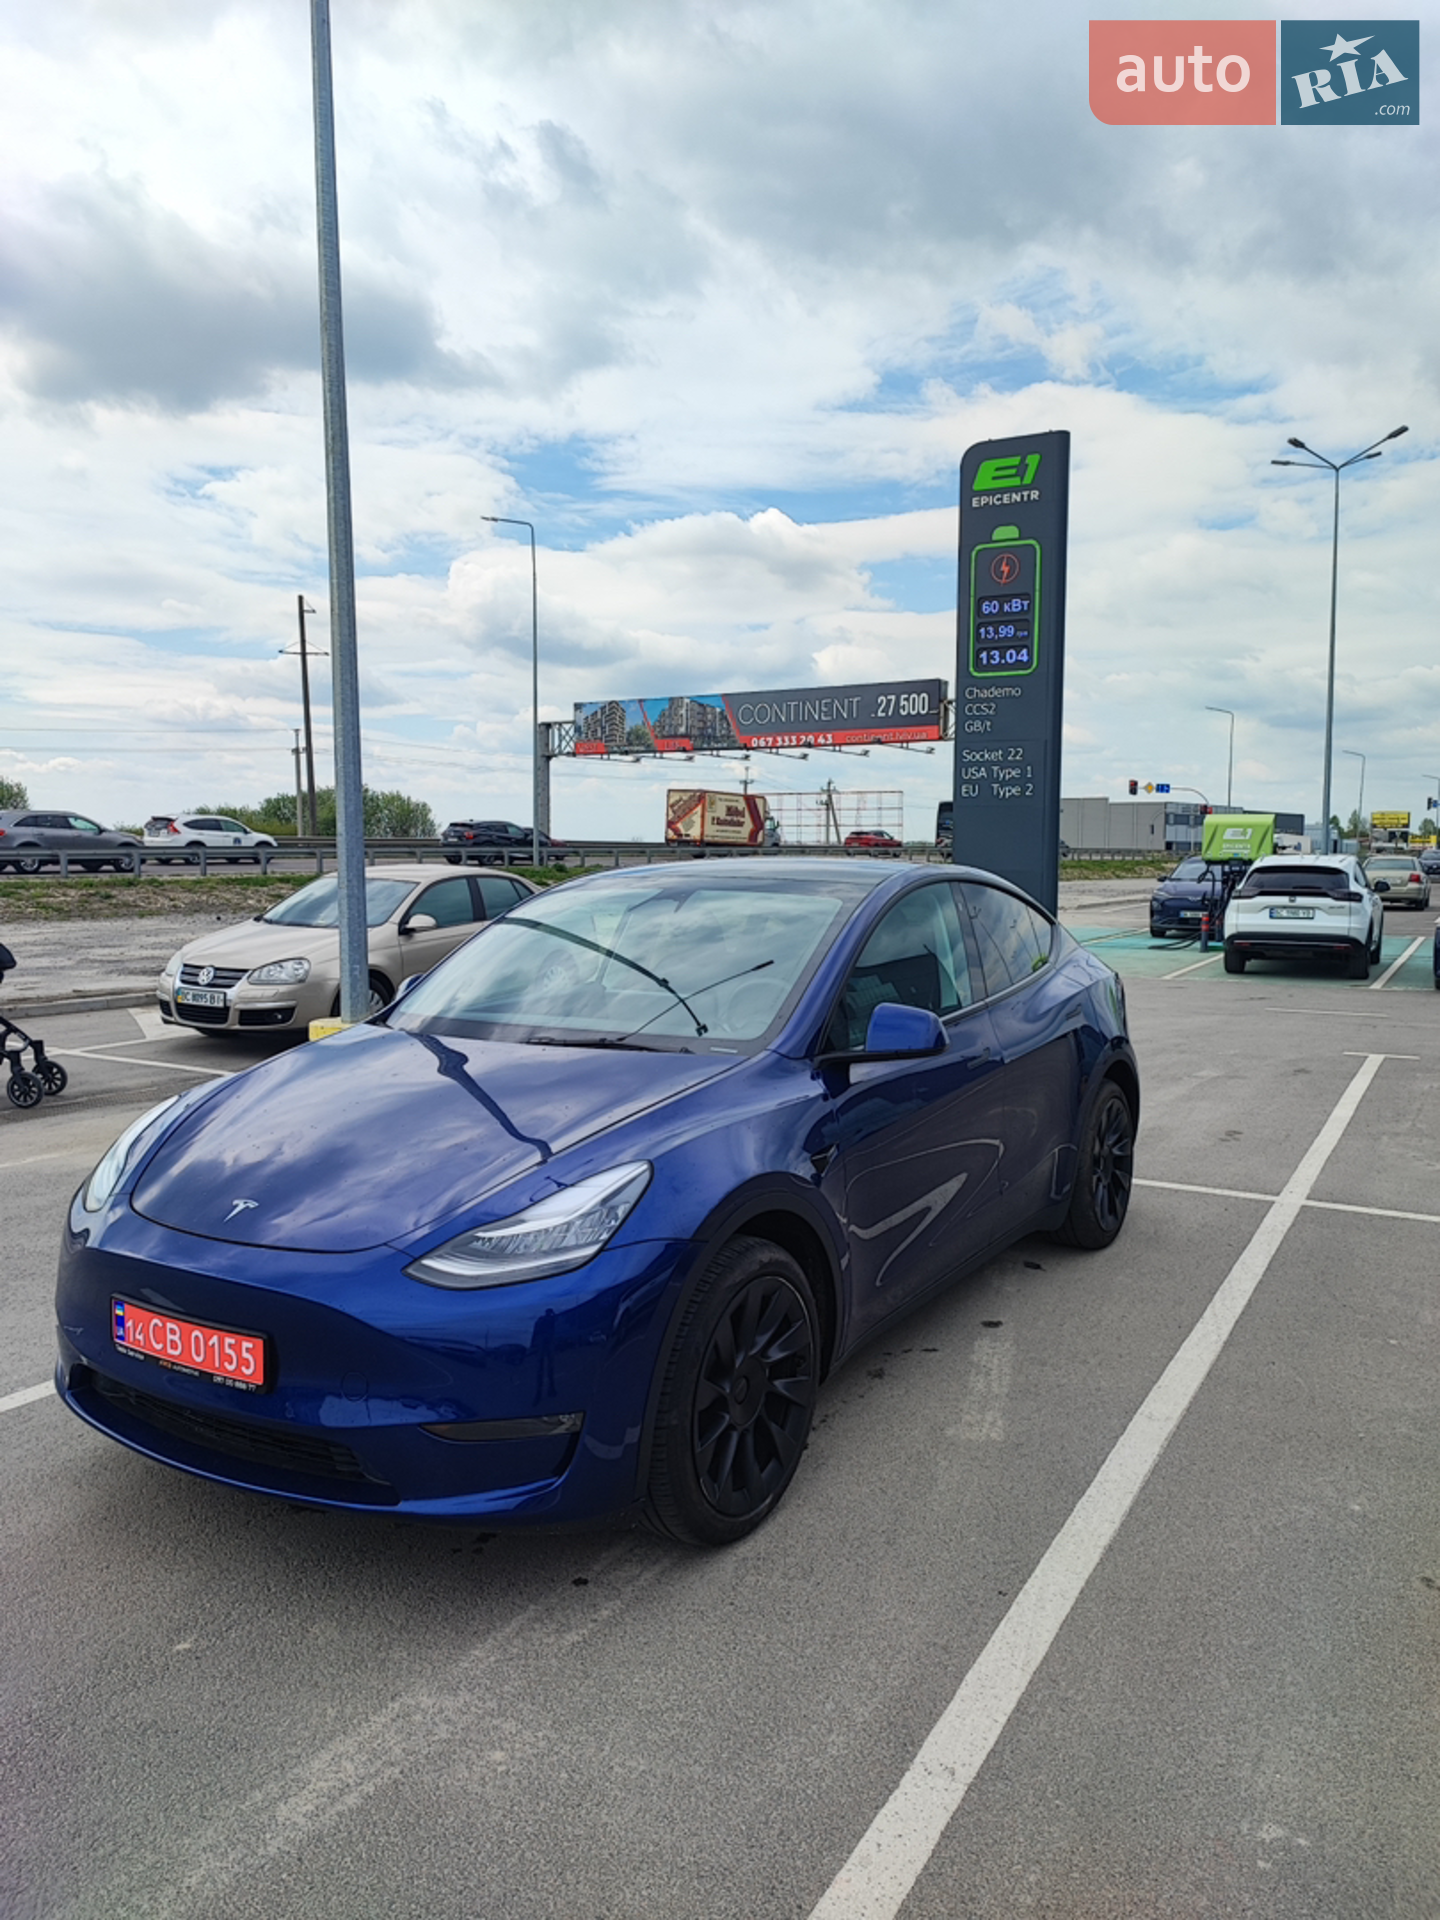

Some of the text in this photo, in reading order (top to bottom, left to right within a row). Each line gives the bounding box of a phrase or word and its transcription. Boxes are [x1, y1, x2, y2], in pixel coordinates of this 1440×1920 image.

[972, 489, 1040, 508] EPICENTR
[982, 598, 1030, 615] 60 кВт
[979, 625, 1015, 640] 13,99
[979, 648, 1029, 665] 13.04
[964, 686, 1022, 700] Chademo
[738, 697, 861, 725] CONTINENT
[964, 703, 997, 716] CCS2
[964, 720, 992, 734] GB/t
[751, 735, 773, 748] 067
[776, 734, 797, 747] 333
[817, 732, 834, 745] 43
[962, 748, 1023, 762] Socket 22
[961, 766, 1033, 781] USA Type 1
[961, 784, 1034, 799] EU Type 2
[191, 1329, 256, 1376] 0155
